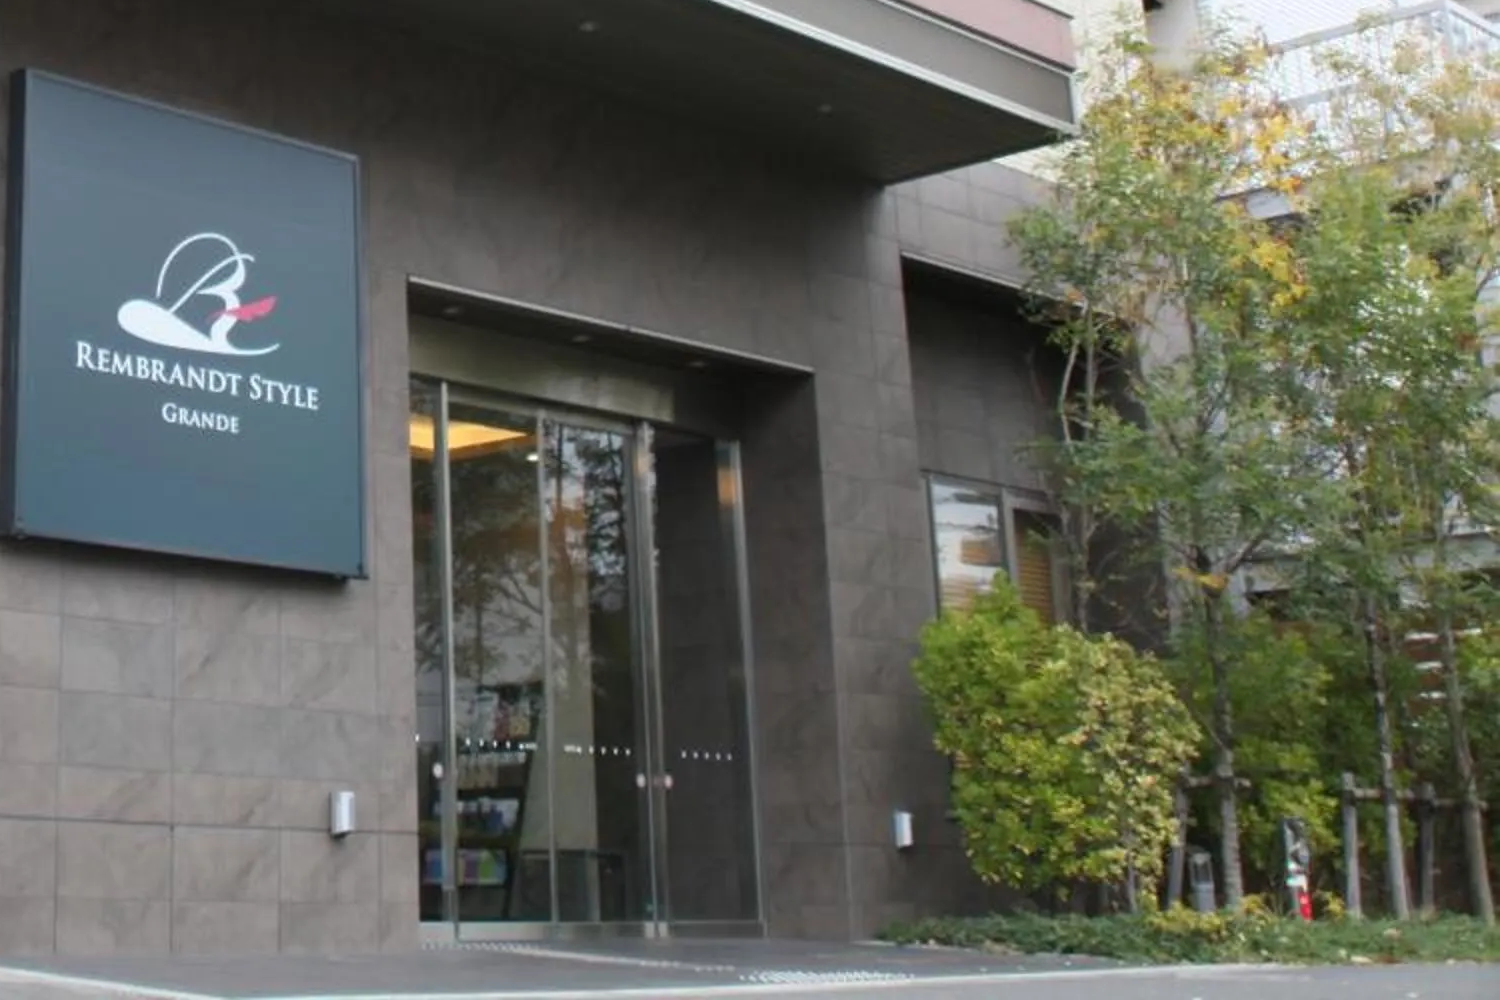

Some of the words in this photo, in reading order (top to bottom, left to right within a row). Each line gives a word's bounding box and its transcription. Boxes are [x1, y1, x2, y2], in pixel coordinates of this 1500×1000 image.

[76, 340, 243, 397] REMBRANDT
[249, 373, 320, 411] STYLE
[161, 402, 240, 434] GRANDE
